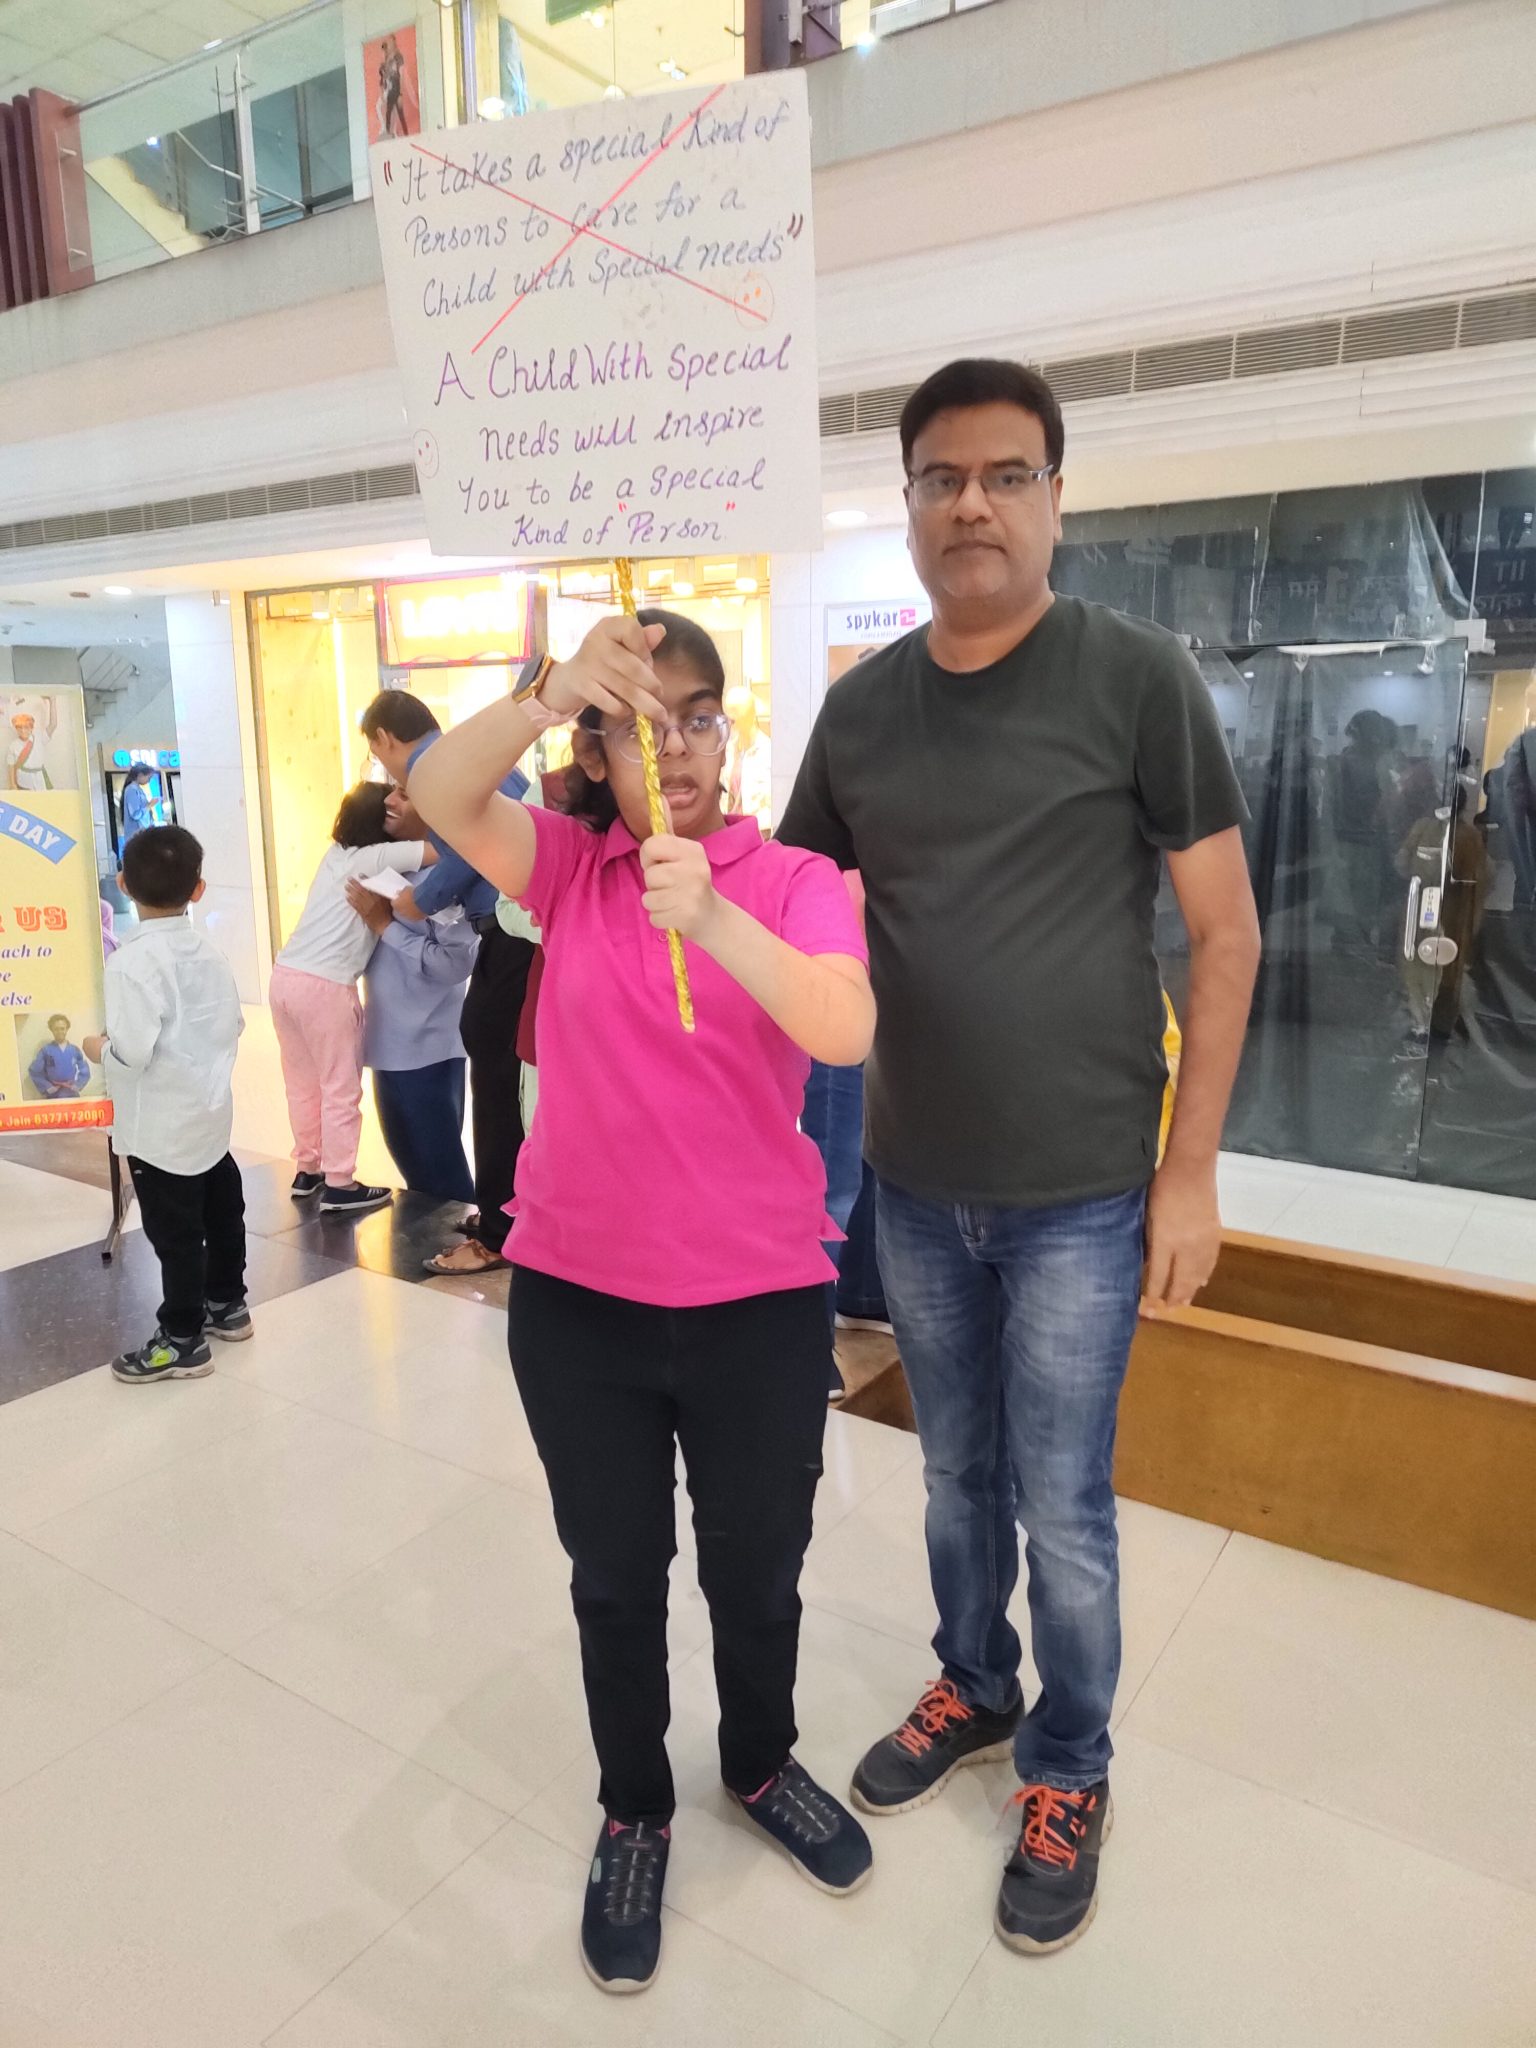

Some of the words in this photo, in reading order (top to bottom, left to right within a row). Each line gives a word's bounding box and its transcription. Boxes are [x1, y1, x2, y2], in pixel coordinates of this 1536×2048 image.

[526, 152, 547, 182] a
[754, 98, 791, 142] of
[404, 214, 507, 258] Persons
[520, 202, 550, 242] to
[655, 180, 702, 222] for
[720, 187, 746, 212] a
[423, 267, 499, 318] Child
[513, 255, 576, 297] with
[434, 351, 475, 406] A
[489, 345, 580, 398] Child
[667, 333, 792, 393] Special
[574, 414, 637, 454] will
[458, 476, 510, 514] You
[526, 478, 550, 505] to
[570, 470, 593, 502] be
[616, 478, 635, 499] a
[511, 514, 569, 547] Kind
[582, 516, 614, 545] of
[846, 610, 898, 630] spykar
[8, 814, 61, 850] DAY
[14, 906, 68, 932] US
[37, 945, 53, 958] to
[0, 991, 32, 1006] else
